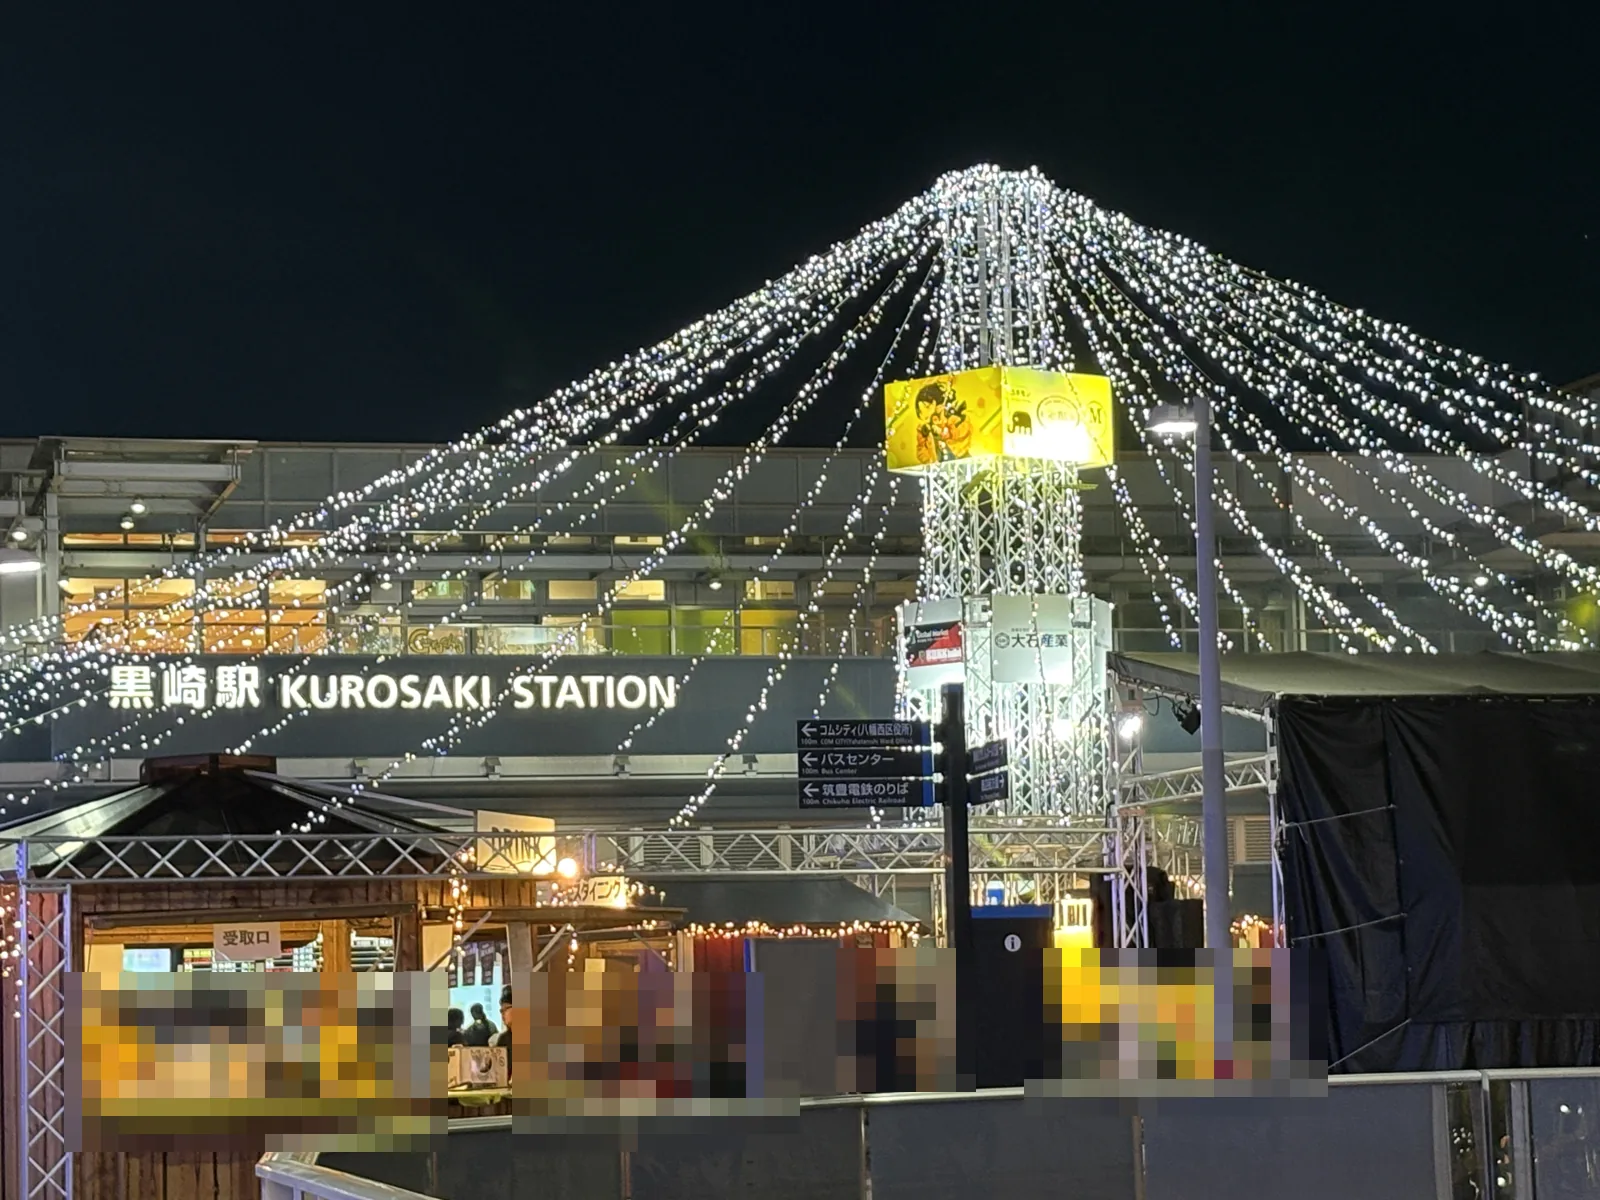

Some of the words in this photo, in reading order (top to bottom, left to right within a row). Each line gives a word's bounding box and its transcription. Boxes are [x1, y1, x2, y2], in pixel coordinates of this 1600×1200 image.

[1011, 633, 1068, 648] 大石産業
[108, 663, 260, 708] 黒崎駅
[281, 674, 491, 708] KUROSAKI
[512, 674, 676, 708] STATION
[820, 723, 913, 736] コムシティ(八幡西区役所)
[820, 753, 894, 765] バスセンター
[822, 783, 909, 796] 筑豊電鉄のりば
[222, 930, 271, 946] 受取口
